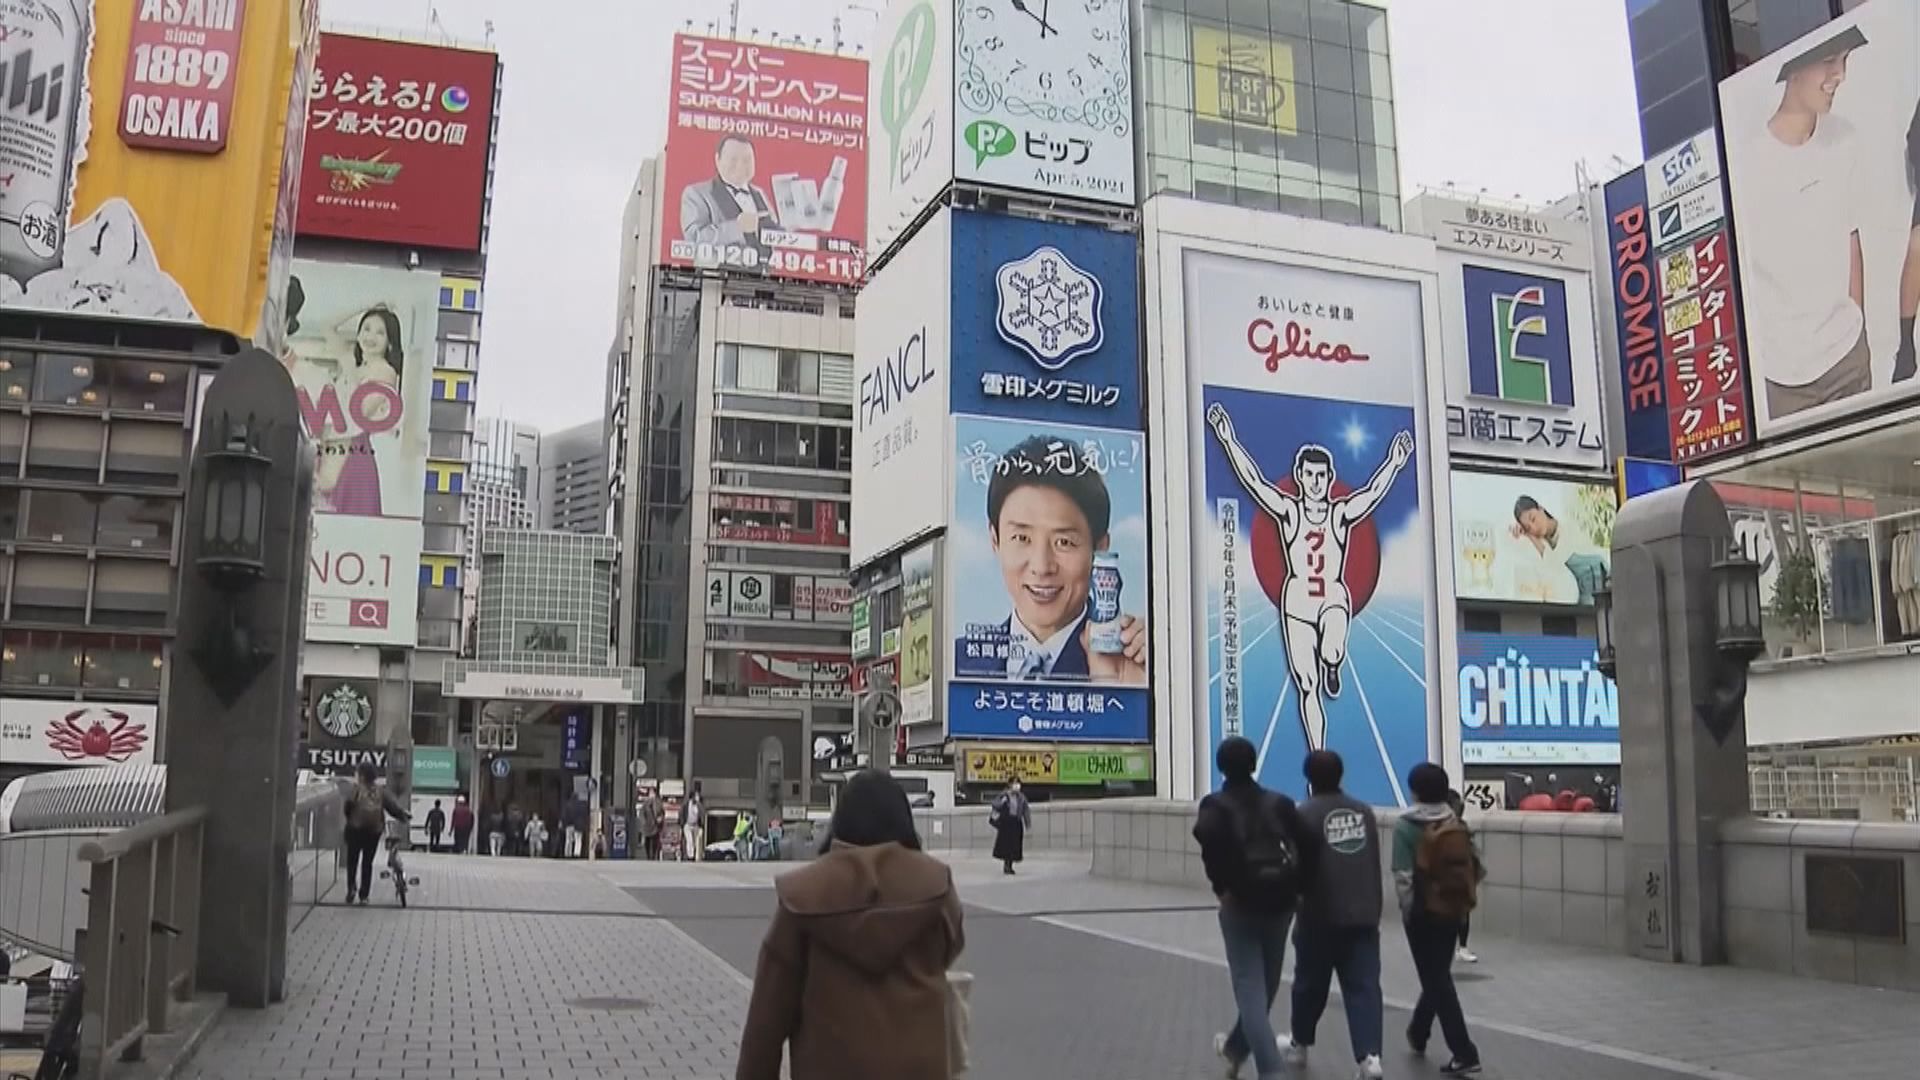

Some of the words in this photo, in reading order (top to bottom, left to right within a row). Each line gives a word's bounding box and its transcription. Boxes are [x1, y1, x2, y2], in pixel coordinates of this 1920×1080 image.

[164, 27, 206, 46] since
[681, 39, 785, 72] スーパー
[134, 43, 230, 90] 1889
[680, 64, 865, 105] ミリオンヘアー
[125, 93, 219, 142] OSAKA
[307, 108, 468, 145] ブ最大200個
[679, 91, 741, 113] SUPER
[746, 102, 813, 122] MILLION
[818, 110, 863, 130] HAIR
[1025, 131, 1093, 165] ピップ
[23, 214, 57, 249] お酒
[1453, 229, 1564, 261] エステムシリーズ
[1257, 295, 1355, 322] おいしさと健康
[1614, 203, 1662, 411] PROMISE
[1247, 318, 1369, 373] Glico
[1697, 235, 1739, 425] インターネット
[860, 325, 935, 432] FANCL
[981, 371, 1120, 406] 雪印メグミルク
[1671, 328, 1704, 436] コミック
[1447, 405, 1603, 450] 日商エステム
[1303, 528, 1326, 598] グリコ
[974, 690, 1125, 713] ようこそ道頓堀へ
[308, 750, 388, 767] TSUTAY
